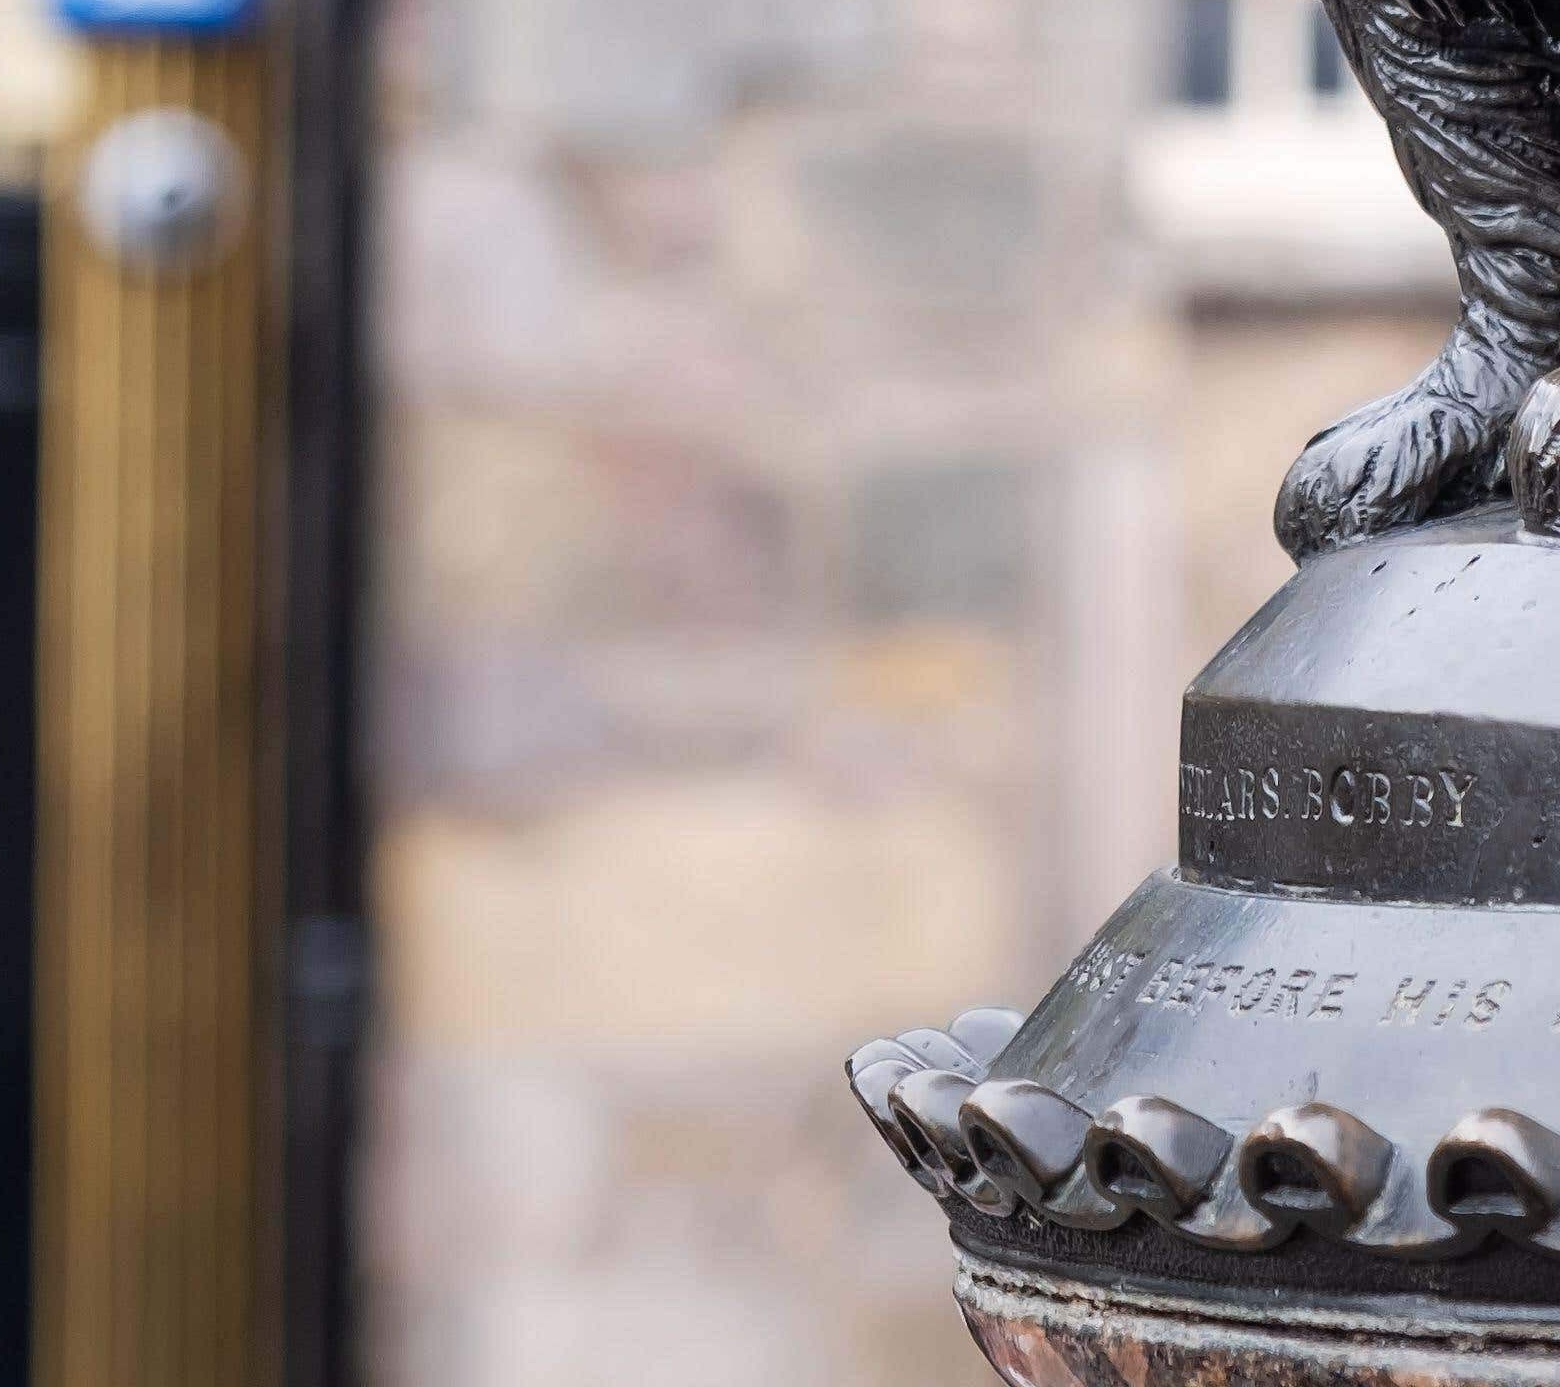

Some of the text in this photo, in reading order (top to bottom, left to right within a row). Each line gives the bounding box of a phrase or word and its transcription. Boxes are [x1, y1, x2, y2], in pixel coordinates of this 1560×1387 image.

[1300, 765, 1478, 827] BOBBY
[1136, 958, 1359, 1020] BEFORE
[1377, 975, 1513, 1028] HIS
